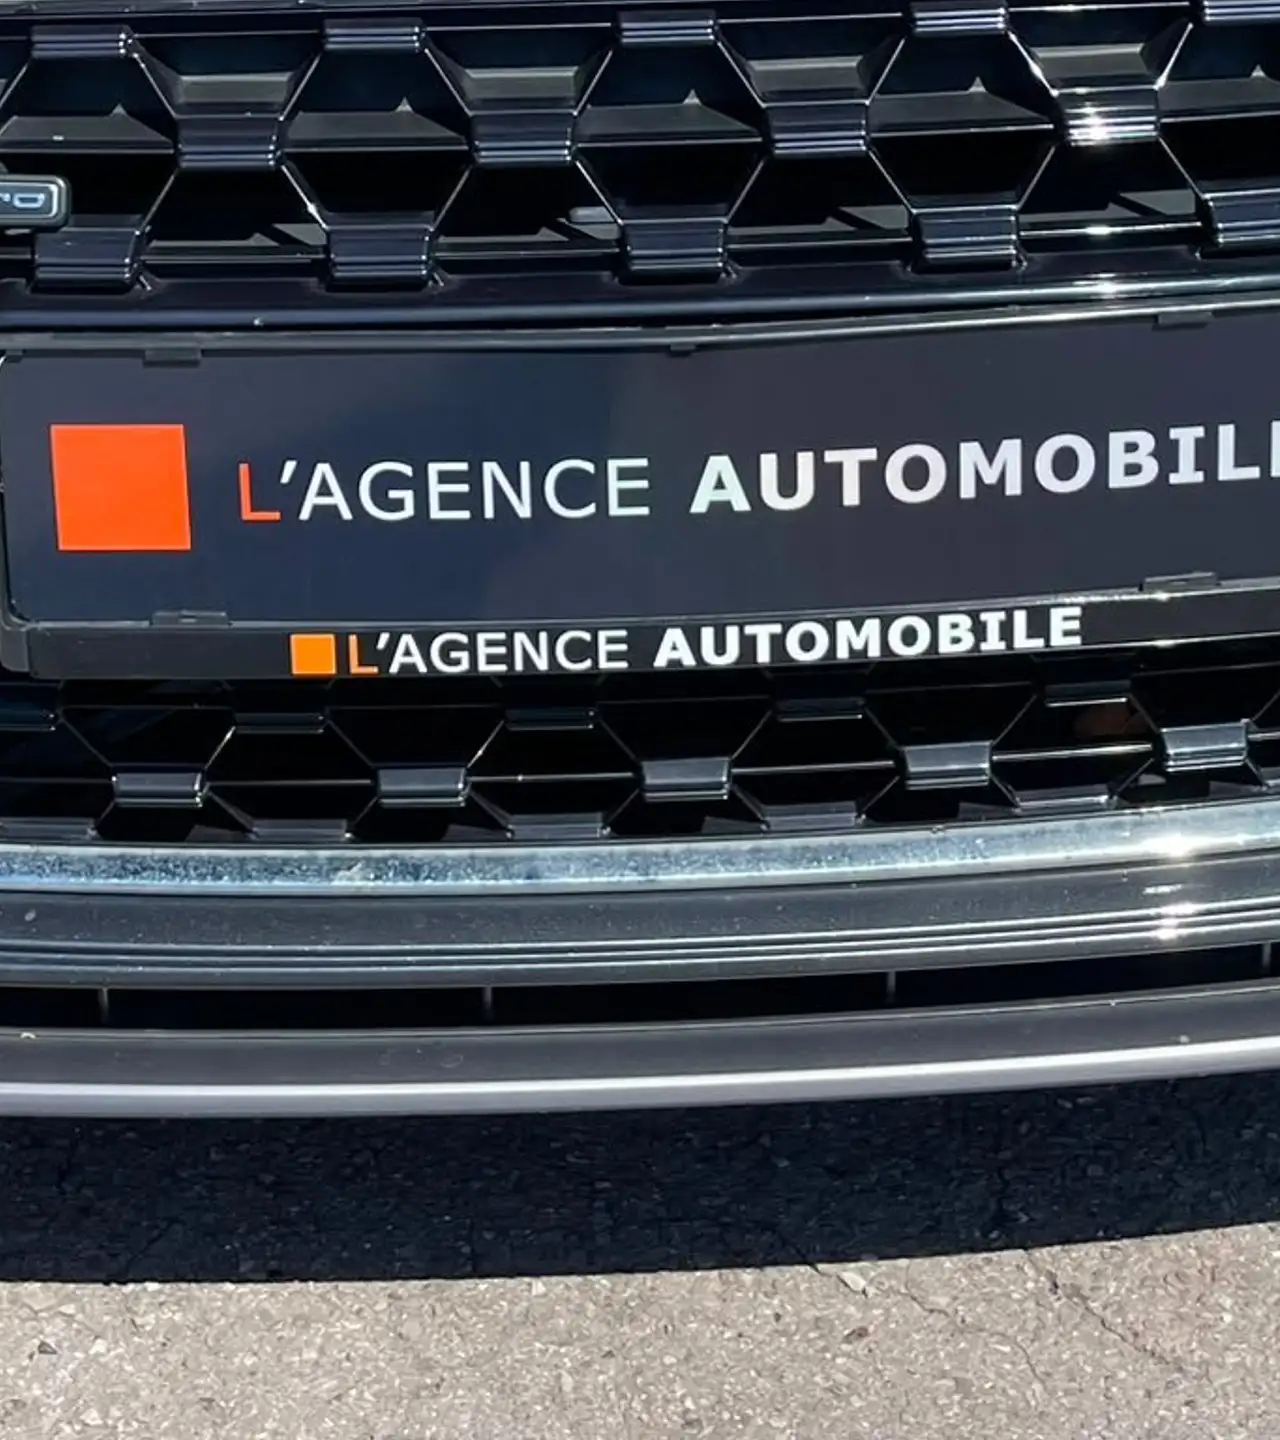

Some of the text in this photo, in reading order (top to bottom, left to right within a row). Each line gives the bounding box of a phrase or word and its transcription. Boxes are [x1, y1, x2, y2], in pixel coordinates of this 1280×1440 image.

[237, 459, 651, 522] L'AGENCE
[347, 605, 1083, 676] L'AGENCE AUTOMOBILE
